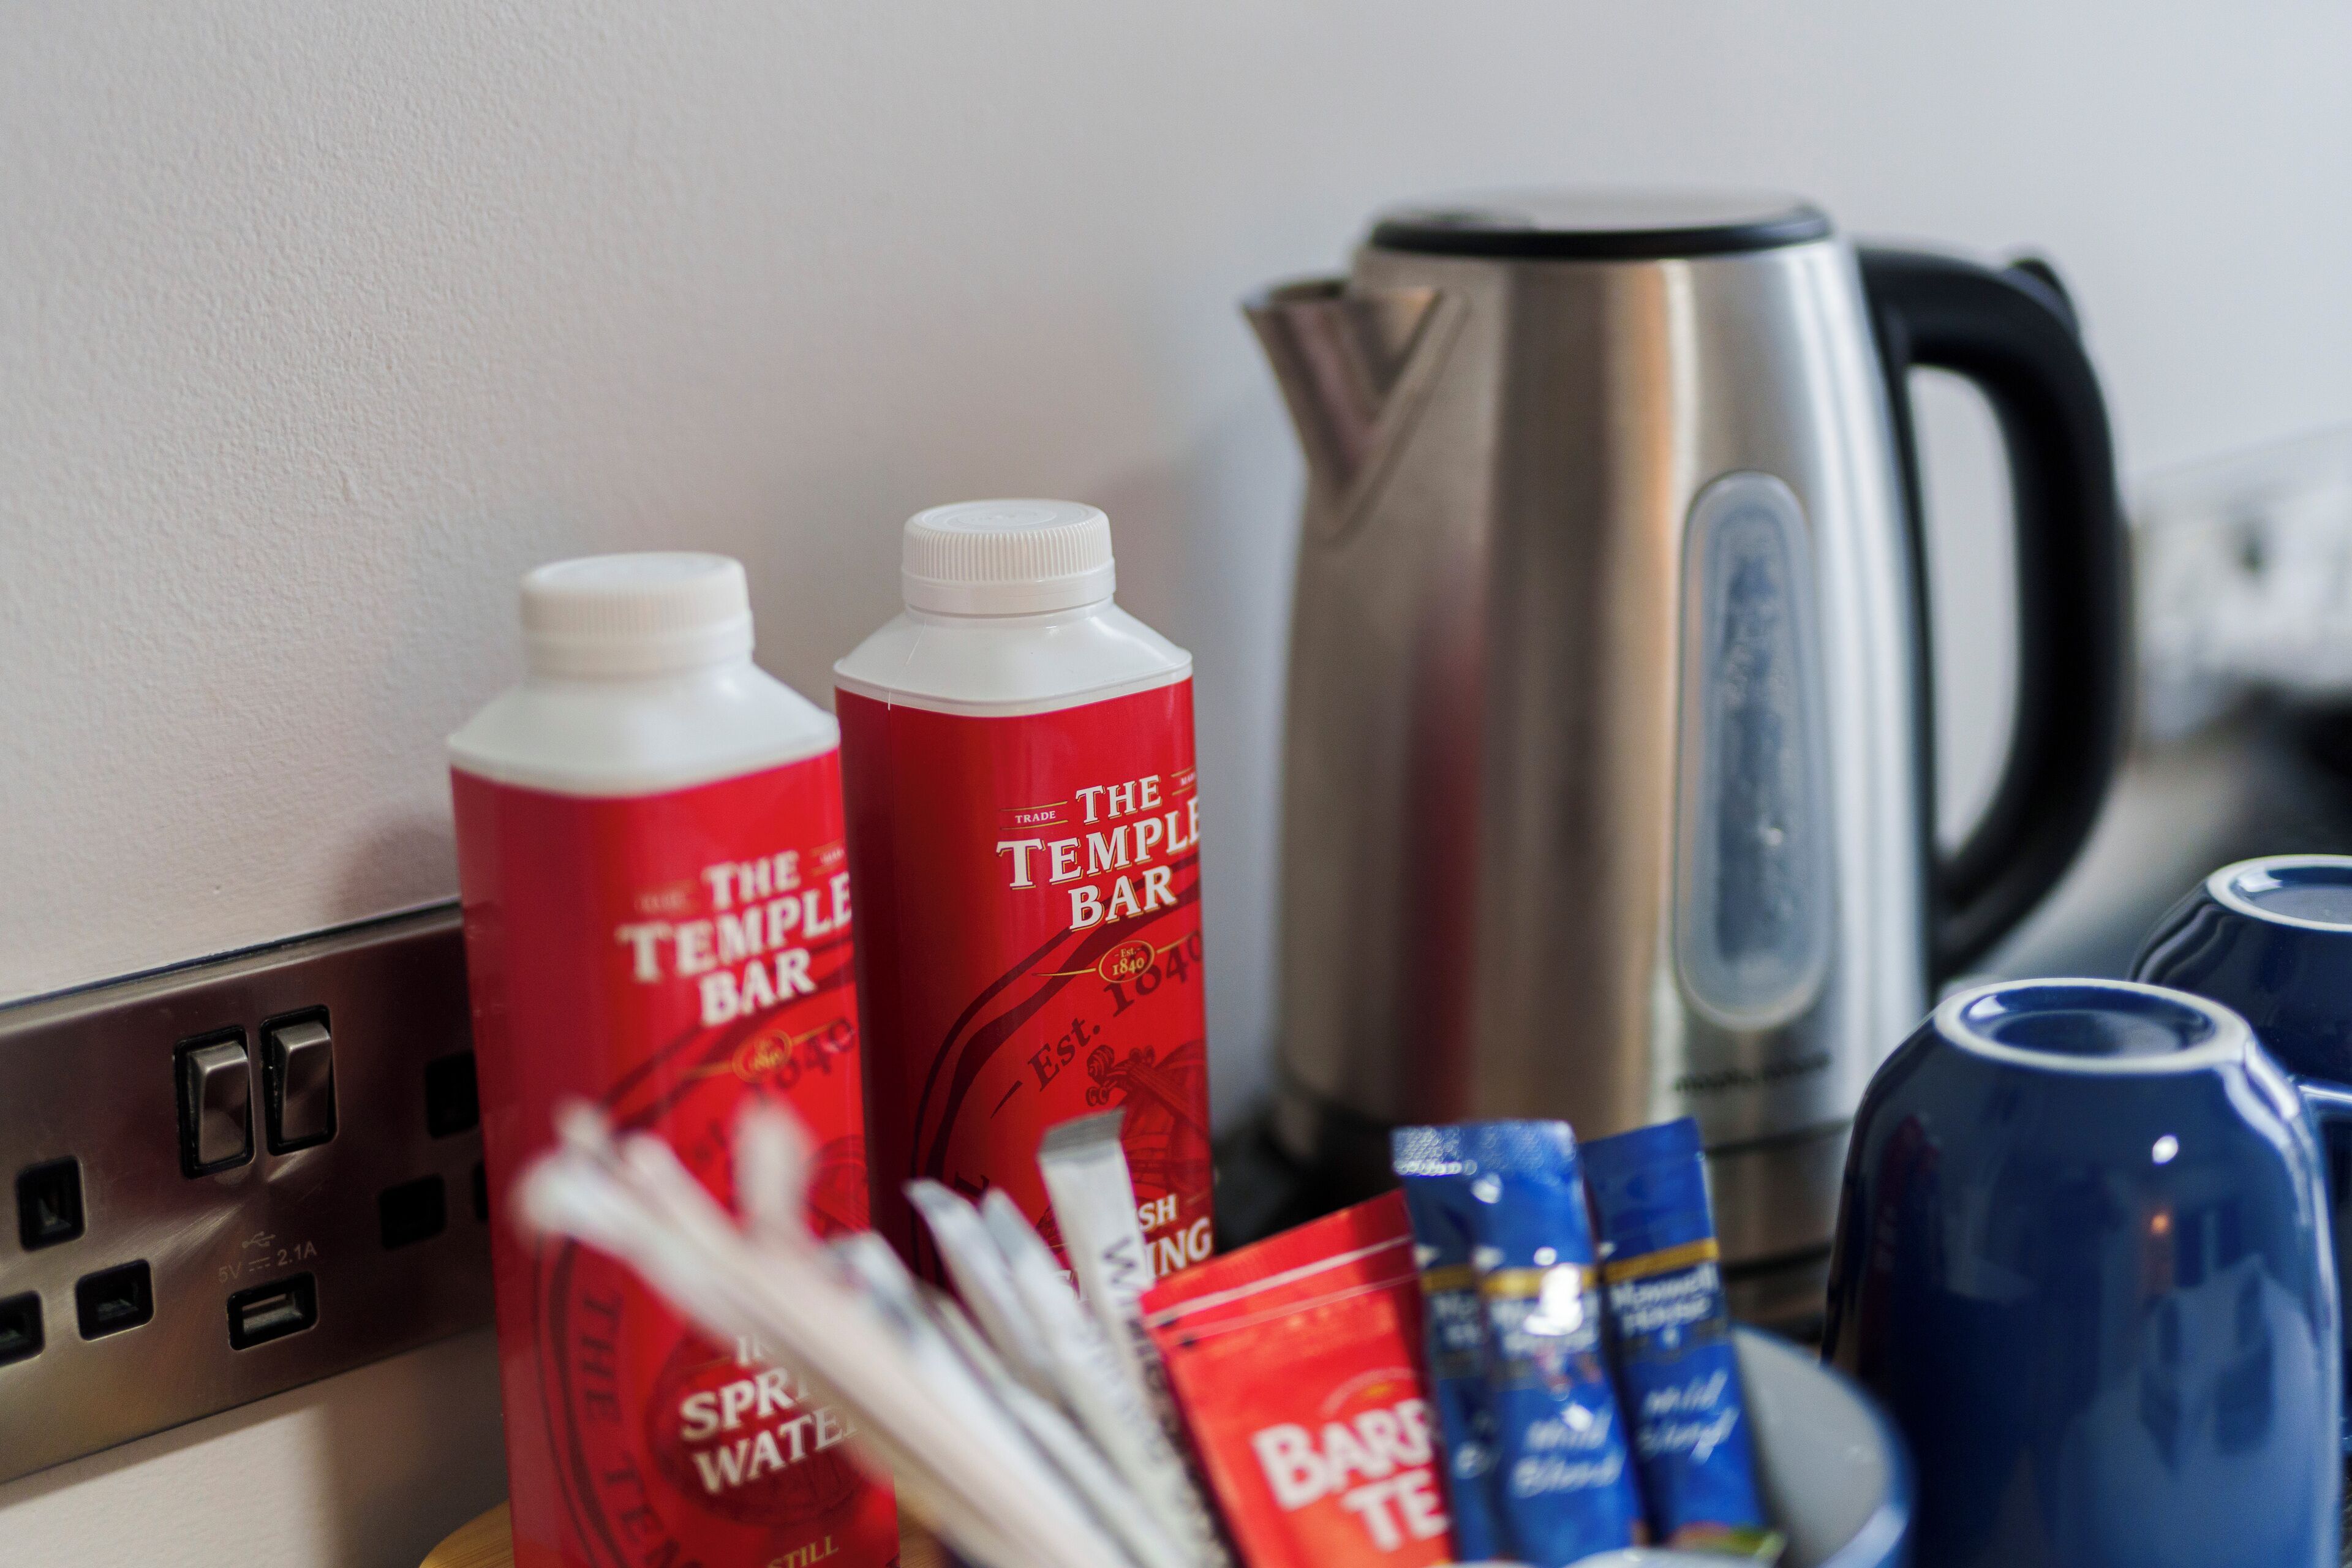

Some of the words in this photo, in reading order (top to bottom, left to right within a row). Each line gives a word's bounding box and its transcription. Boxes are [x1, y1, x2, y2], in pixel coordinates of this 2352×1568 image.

[1015, 810, 1057, 824] TRADE
[1076, 775, 1163, 824] THE
[996, 796, 1200, 890] TEMPLE
[701, 850, 801, 910] THE
[1068, 865, 1178, 931] BAR
[614, 871, 852, 983] TEMPLE
[699, 947, 818, 1028] BAR
[1112, 957, 1145, 976] 1840
[1027, 1017, 1101, 1093] Est.
[218, 1261, 243, 1284] 5V
[276, 1240, 318, 1267] 2.1A
[1340, 1469, 1452, 1552] TE
